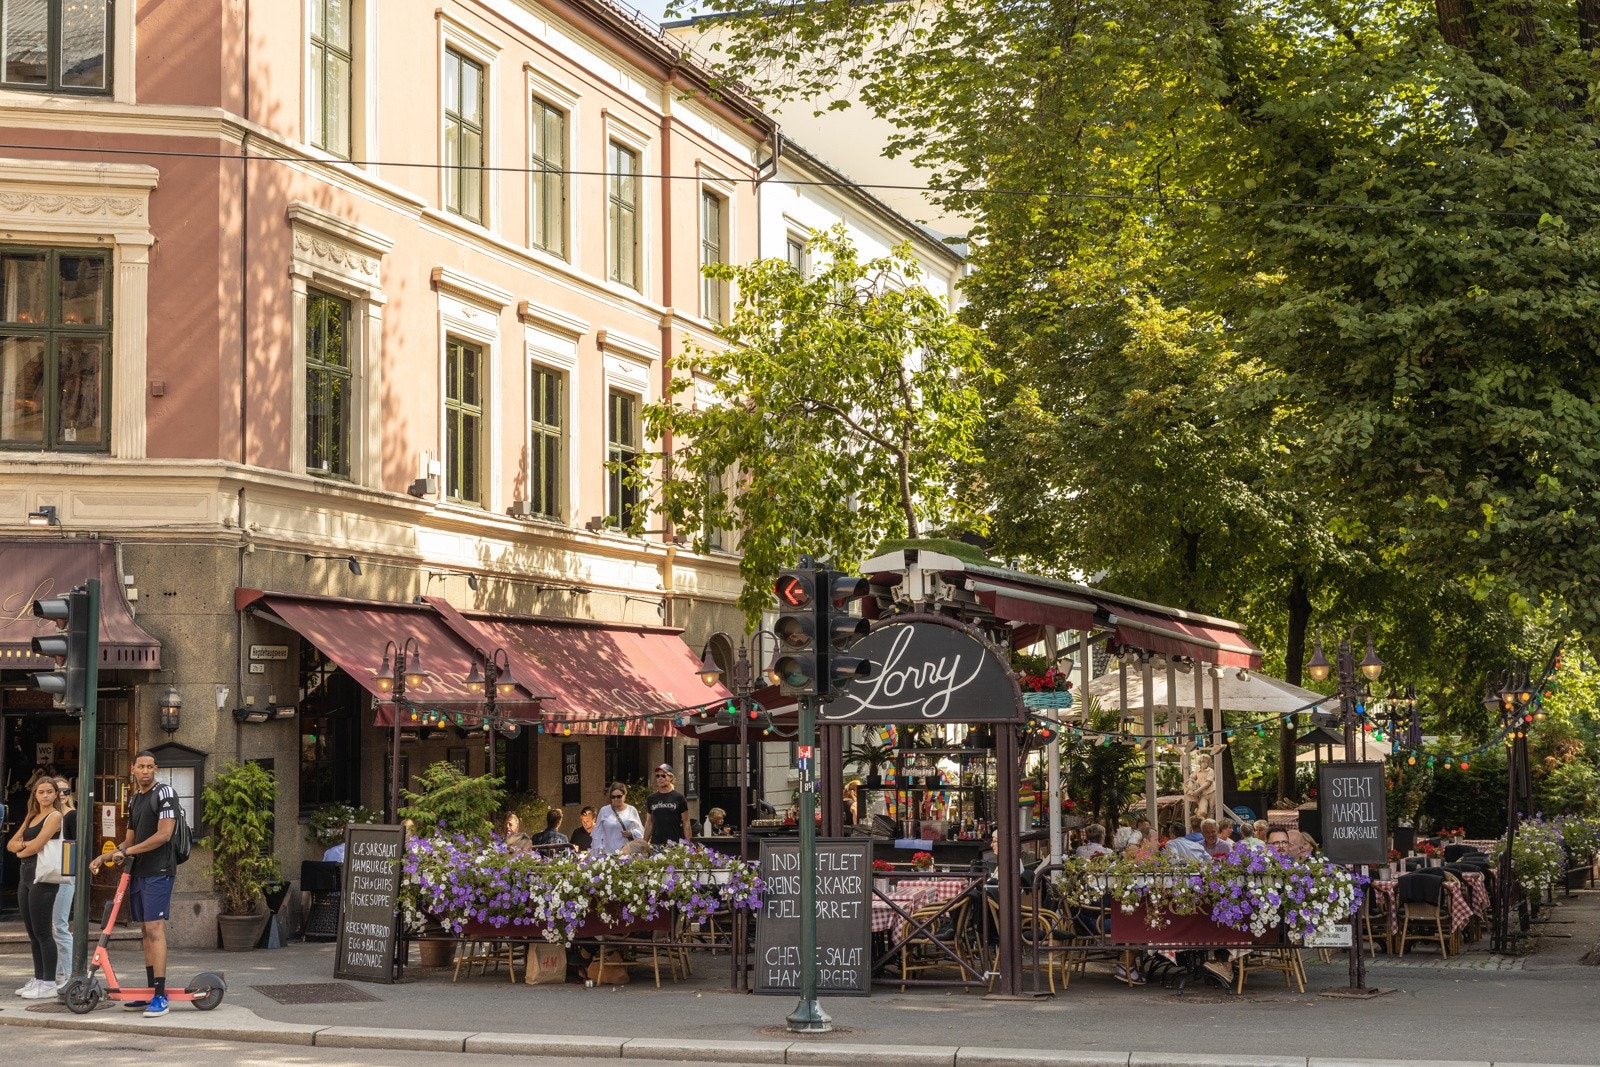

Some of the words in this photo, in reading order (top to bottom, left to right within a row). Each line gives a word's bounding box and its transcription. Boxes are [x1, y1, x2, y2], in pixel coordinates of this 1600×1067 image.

[820, 625, 986, 719] Lorry
[39, 747, 52, 755] WC
[1332, 776, 1374, 798] STEKT
[1331, 802, 1378, 824] MAKRELL
[1332, 826, 1379, 840] AGURKSALAT
[351, 858, 393, 875] HAMBURGER
[767, 899, 861, 918] FJELØRRET
[347, 951, 383, 968] KARBONADE
[825, 947, 863, 966] SALAT
[768, 969, 858, 988] HAMURGER
